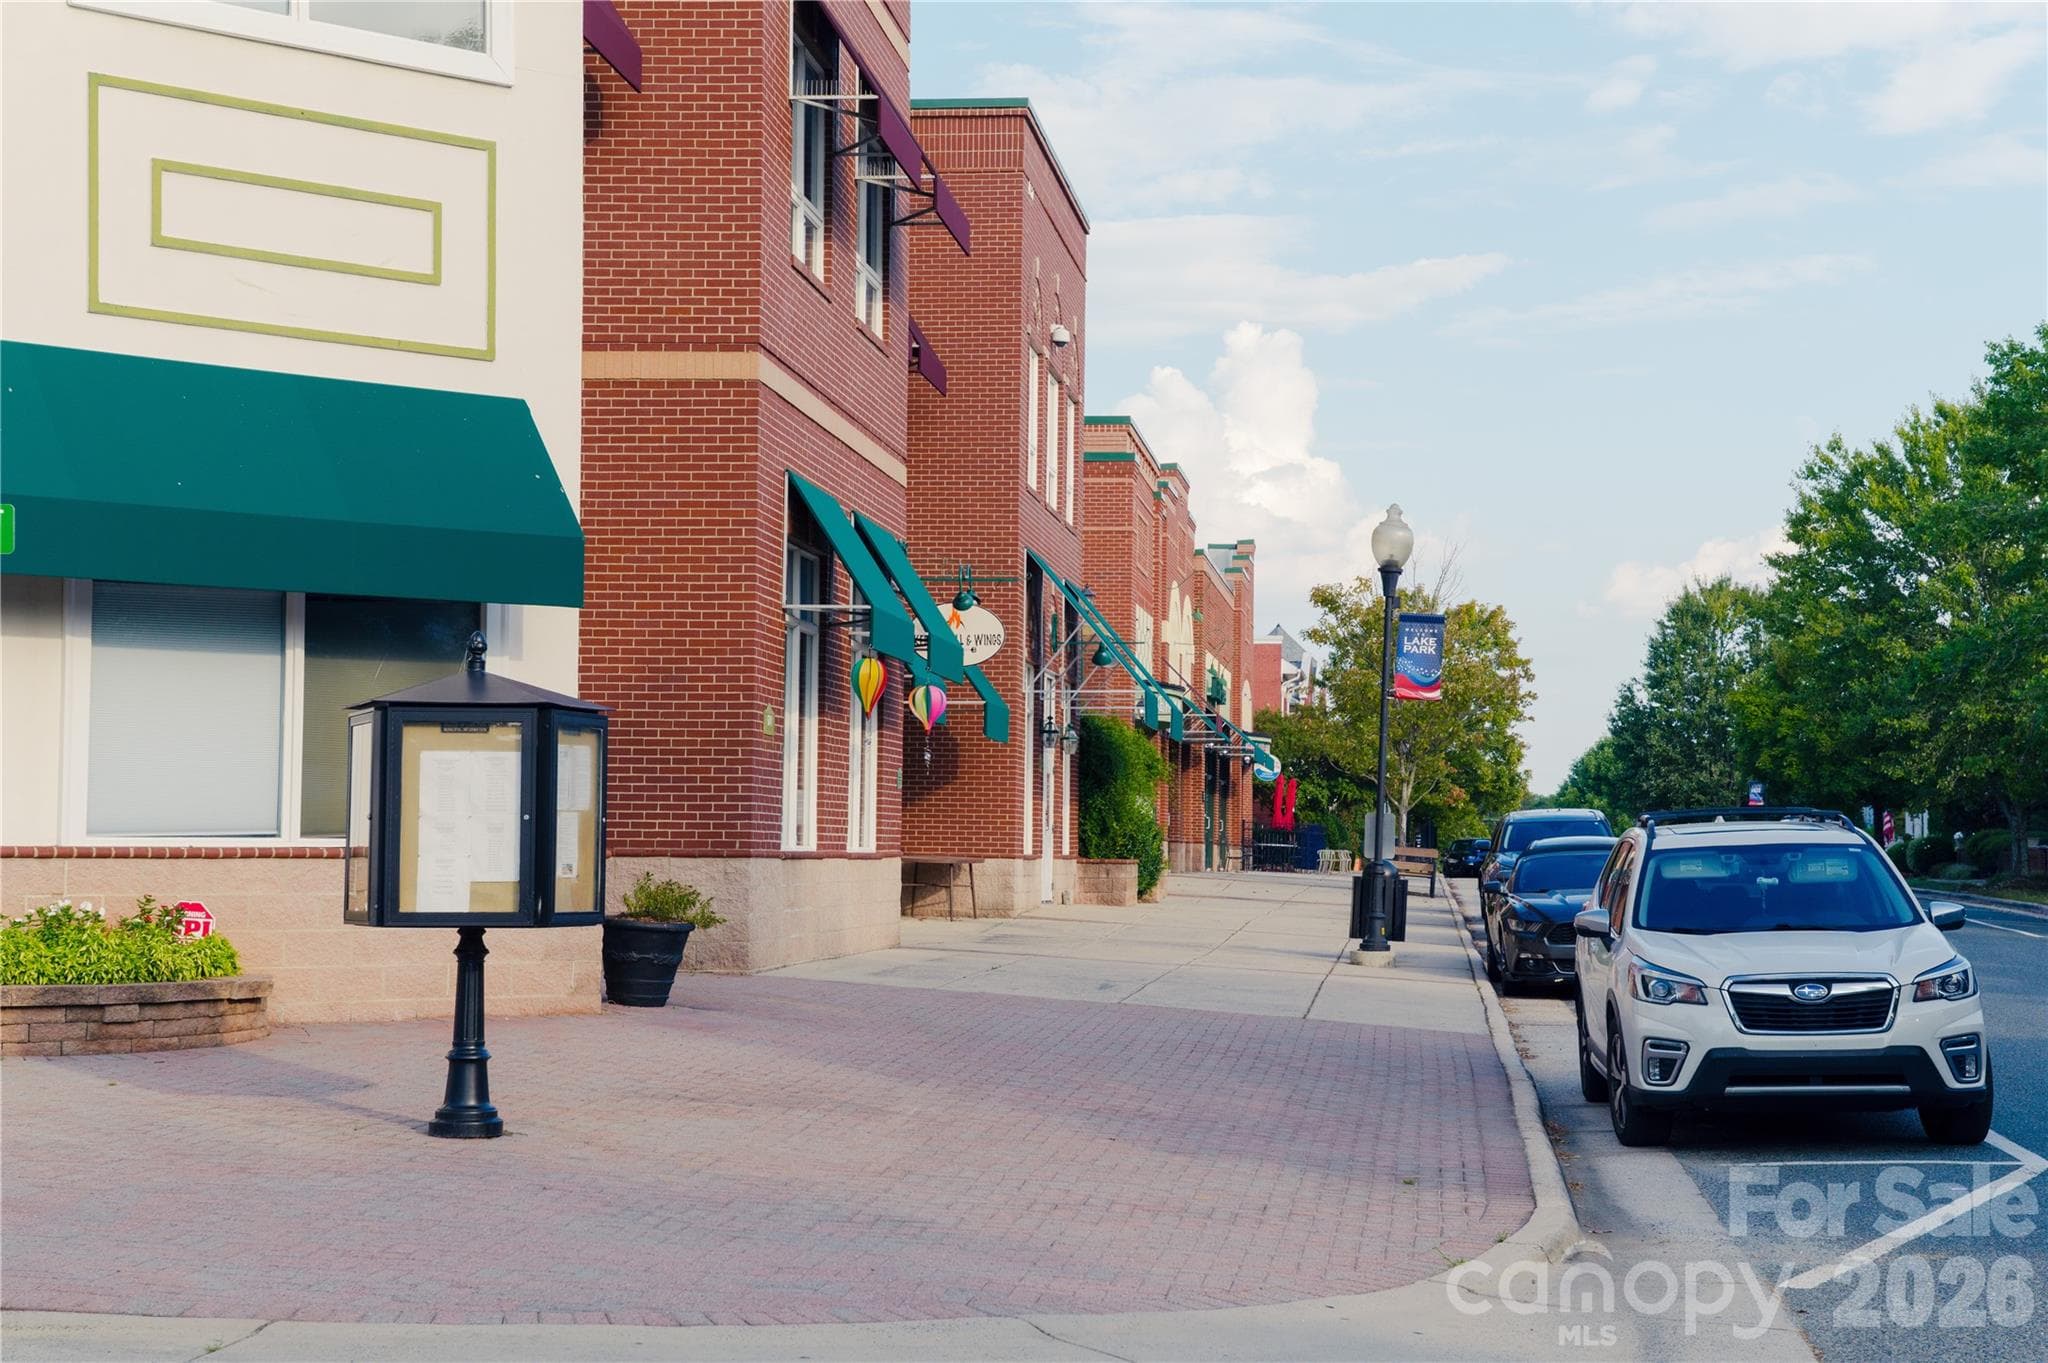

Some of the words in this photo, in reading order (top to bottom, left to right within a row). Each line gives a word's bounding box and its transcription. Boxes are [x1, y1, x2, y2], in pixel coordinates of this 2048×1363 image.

[966, 634, 972, 646] &
[974, 633, 1001, 646] WINGS
[1403, 636, 1437, 646] LAKE
[1403, 645, 1436, 655] PARK
[179, 920, 210, 937] PI
